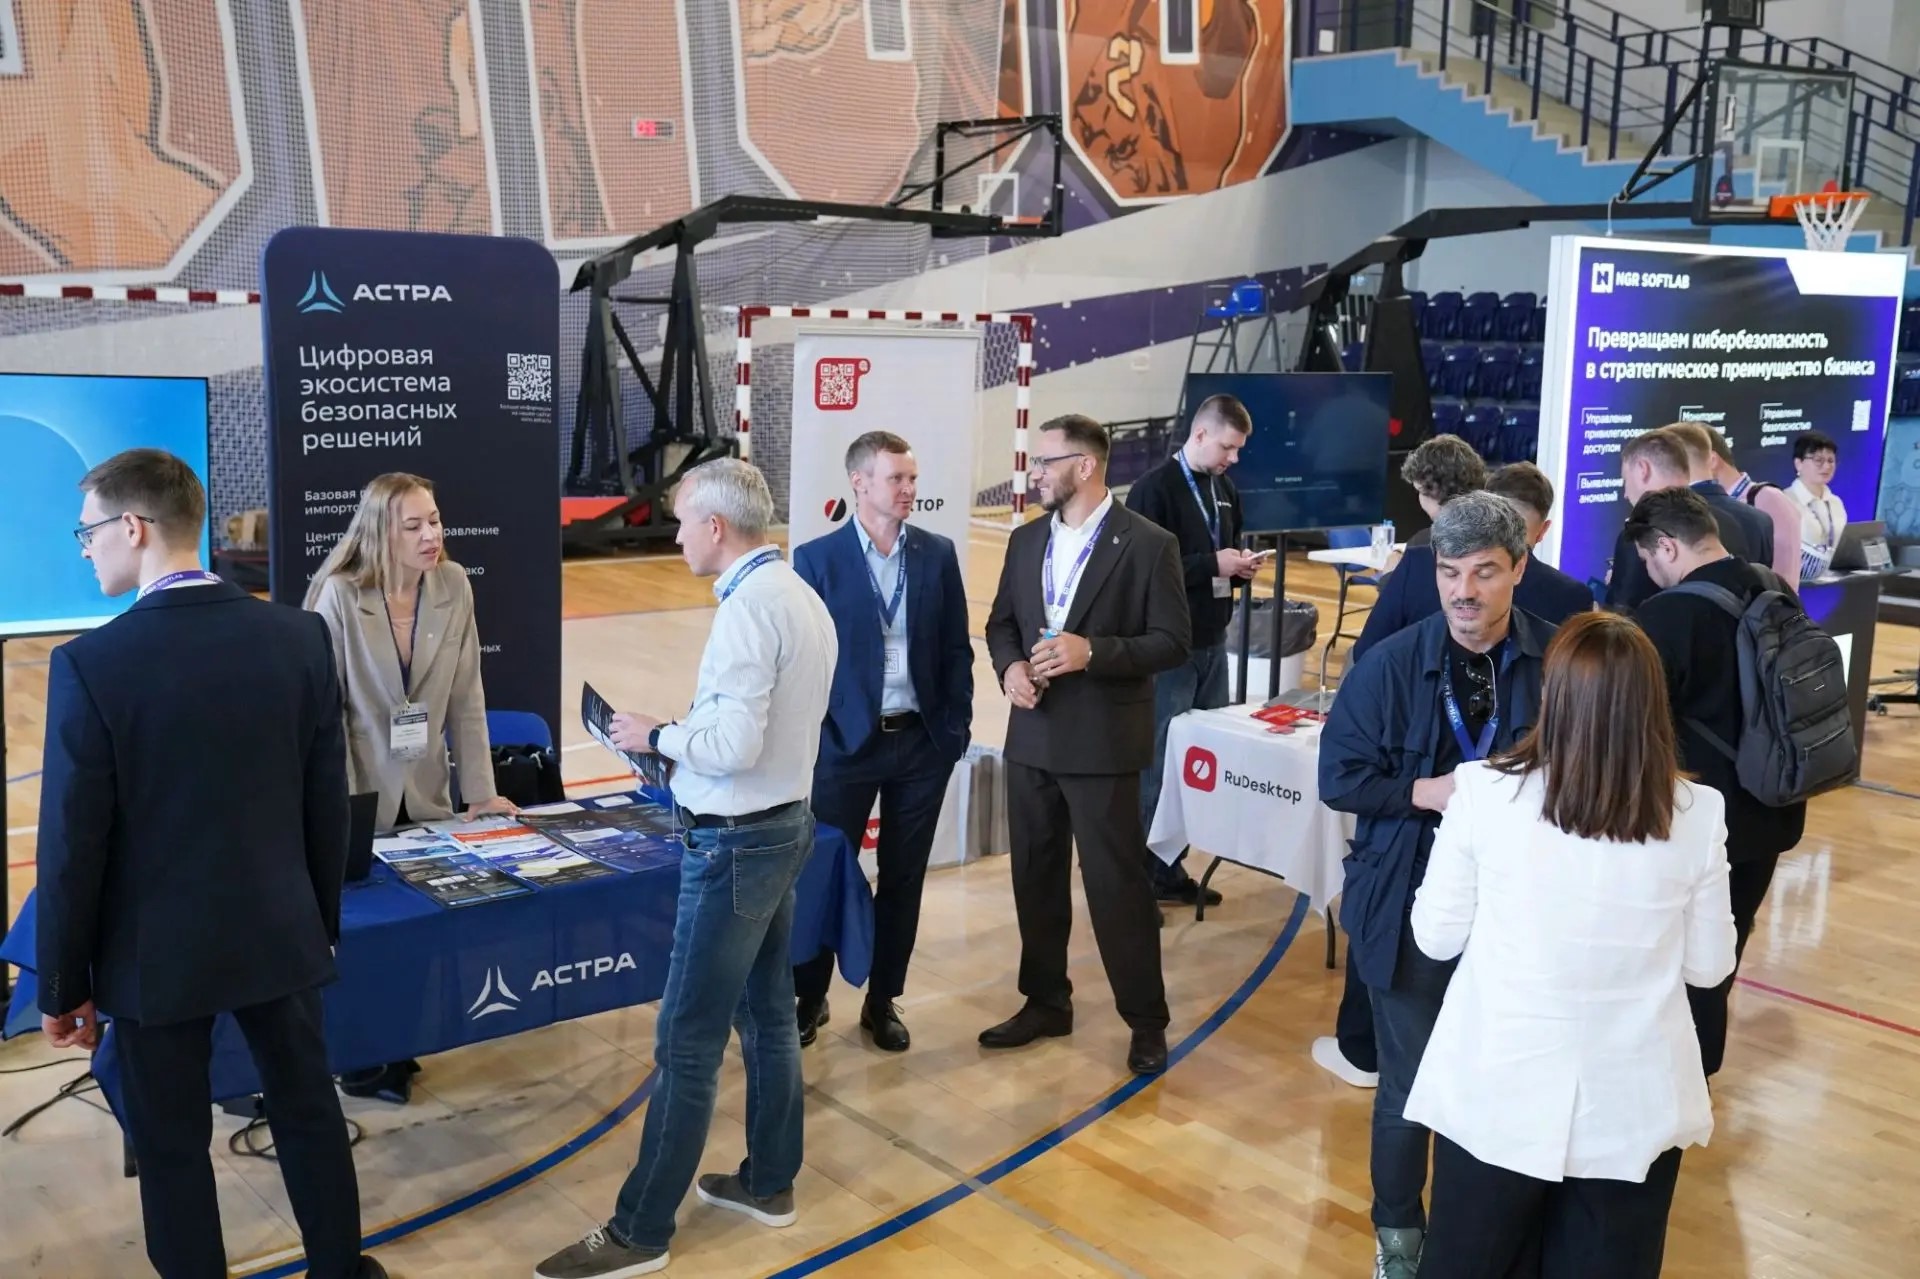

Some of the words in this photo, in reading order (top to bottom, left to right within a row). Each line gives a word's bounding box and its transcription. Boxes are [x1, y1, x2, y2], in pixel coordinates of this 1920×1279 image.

[1615, 271, 1640, 287] NGR
[1641, 272, 1690, 289] SOFTLAB
[353, 283, 453, 302] АСТРА
[1588, 326, 1689, 352] Превращаем
[1692, 328, 1829, 353] кибербезопасность
[299, 343, 434, 370] Цифровая
[1586, 361, 1596, 379] в
[1599, 361, 1720, 383] стратегическое
[1721, 360, 1822, 382] преимущество
[1823, 356, 1876, 376] бизнеса
[300, 374, 452, 395] экосистема
[301, 398, 457, 423] безопасных
[302, 425, 422, 455] решений
[304, 489, 356, 501] Базовая
[911, 498, 944, 511] TOP
[304, 503, 359, 516] импорто
[305, 531, 344, 543] Центр
[443, 526, 500, 537] равление
[1224, 770, 1303, 805] RuDesktop
[530, 952, 637, 992] АСТРА
